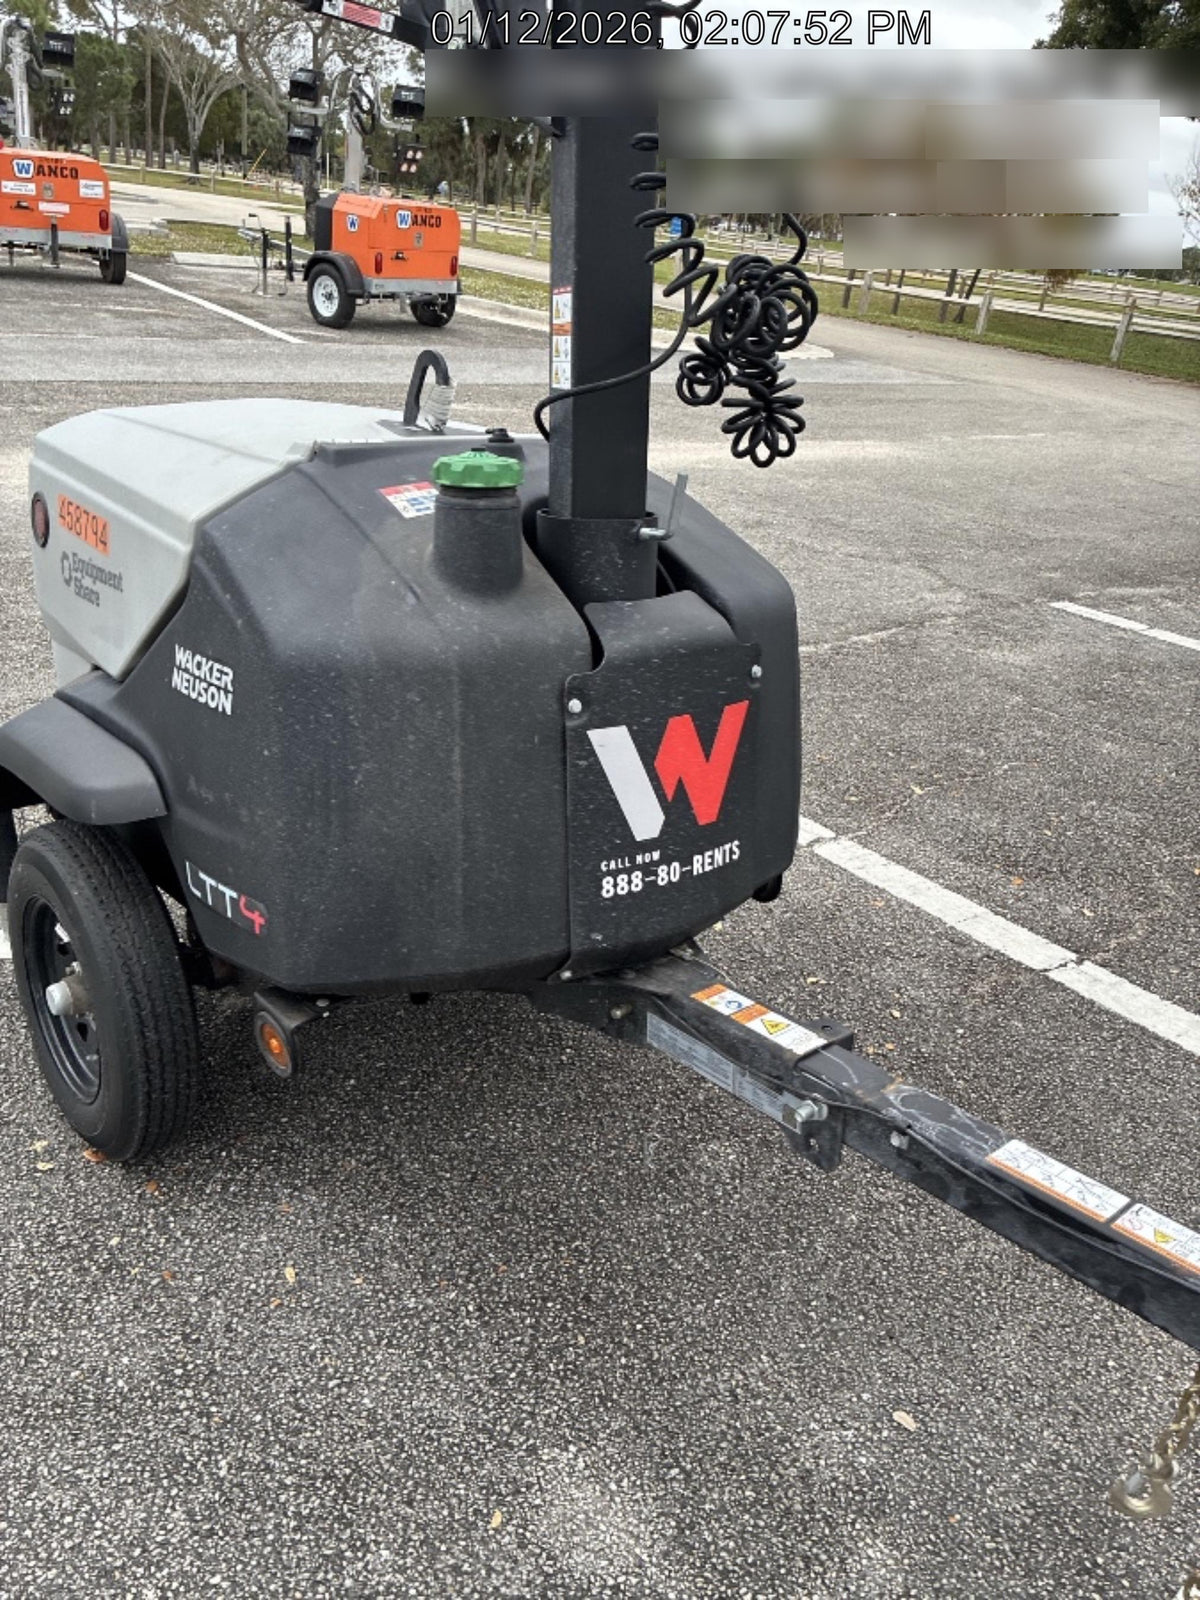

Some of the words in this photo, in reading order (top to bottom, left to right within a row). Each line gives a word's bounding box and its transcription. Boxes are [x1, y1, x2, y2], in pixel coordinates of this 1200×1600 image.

[14, 160, 79, 179] WANCO
[398, 212, 441, 229] WANCO
[58, 496, 107, 547] 458794
[72, 552, 123, 593] Equipment
[74, 575, 100, 607] Share
[175, 643, 233, 692] WACKER
[172, 667, 233, 715] NEUSON
[600, 856, 632, 872] CALL
[636, 849, 661, 866] NOW
[601, 840, 741, 898] 888-80-RENTS
[185, 861, 267, 935] LTT4
